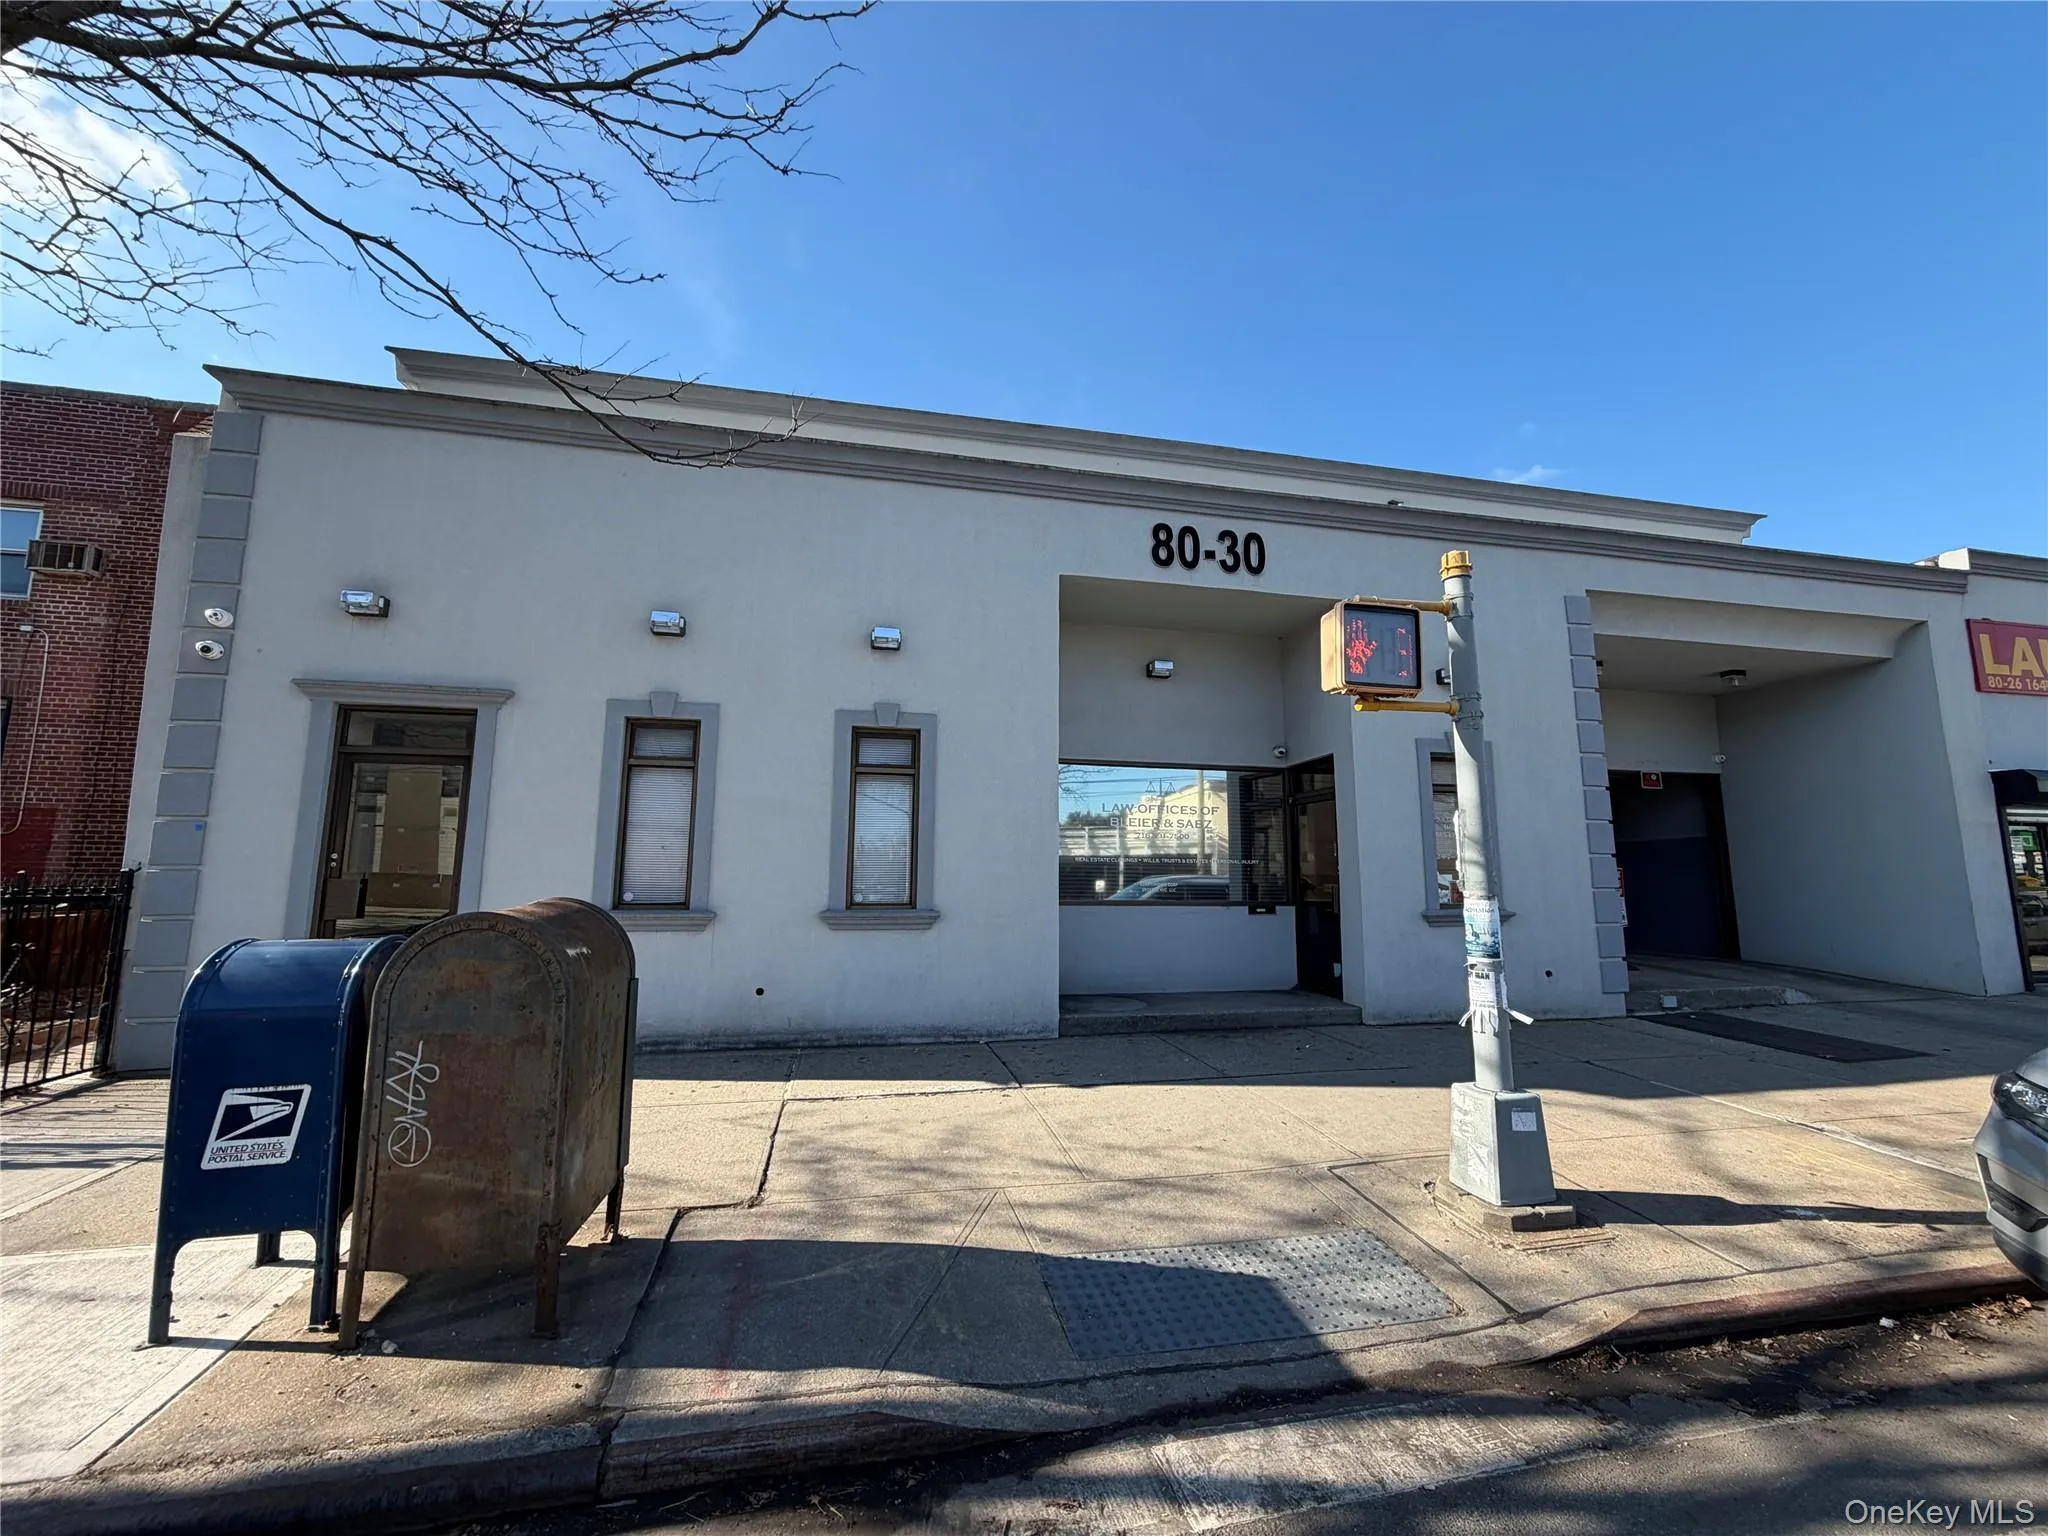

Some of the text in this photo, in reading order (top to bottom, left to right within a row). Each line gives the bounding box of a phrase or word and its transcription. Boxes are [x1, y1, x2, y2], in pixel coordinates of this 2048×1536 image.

[1152, 522, 1266, 575] 80-30
[1988, 676, 2023, 690] 80-26
[1102, 803, 1220, 816] LAW OFFICES OF
[1110, 817, 1160, 828] BLEIER
[1163, 819, 1174, 828] &
[211, 1141, 284, 1154] UNITED STATES
[208, 1150, 287, 1164] POSTAL SERVICE
